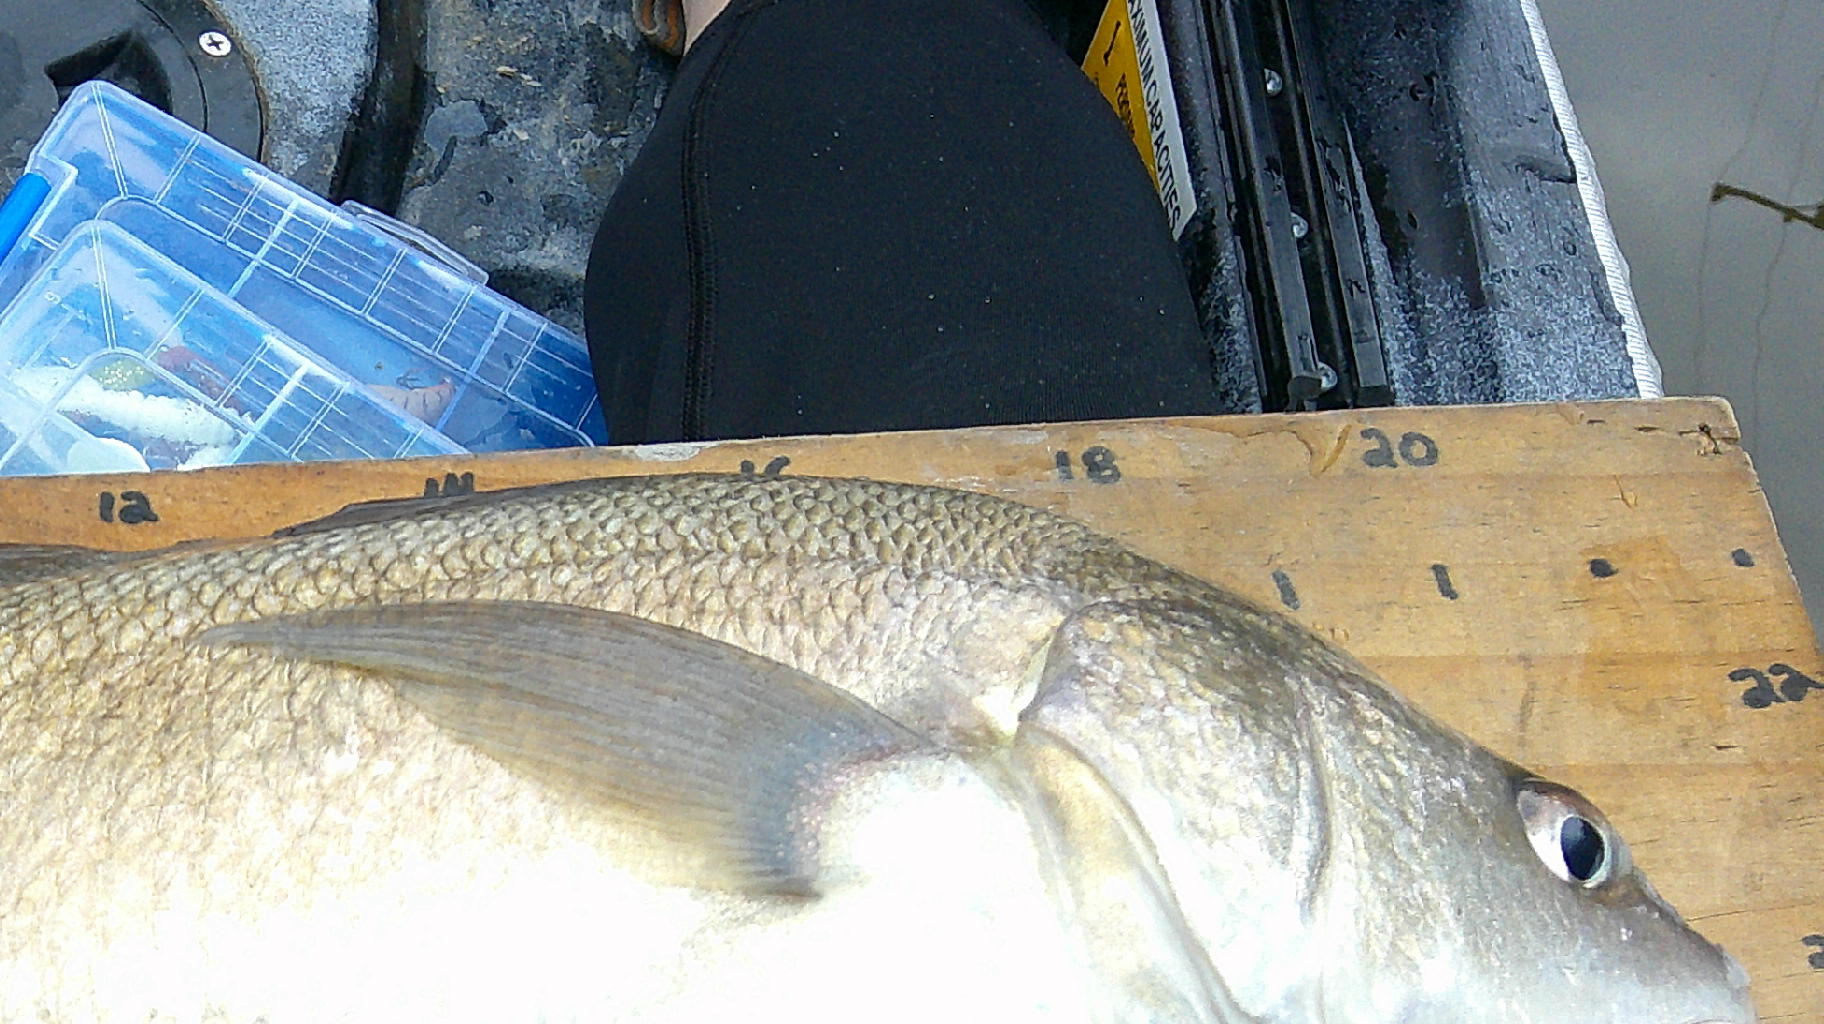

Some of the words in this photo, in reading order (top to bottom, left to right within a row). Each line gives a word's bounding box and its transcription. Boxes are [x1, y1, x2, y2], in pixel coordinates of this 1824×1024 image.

[1054, 445, 1122, 485] 18
[1359, 427, 1439, 469] 20
[99, 490, 160, 525] 12
